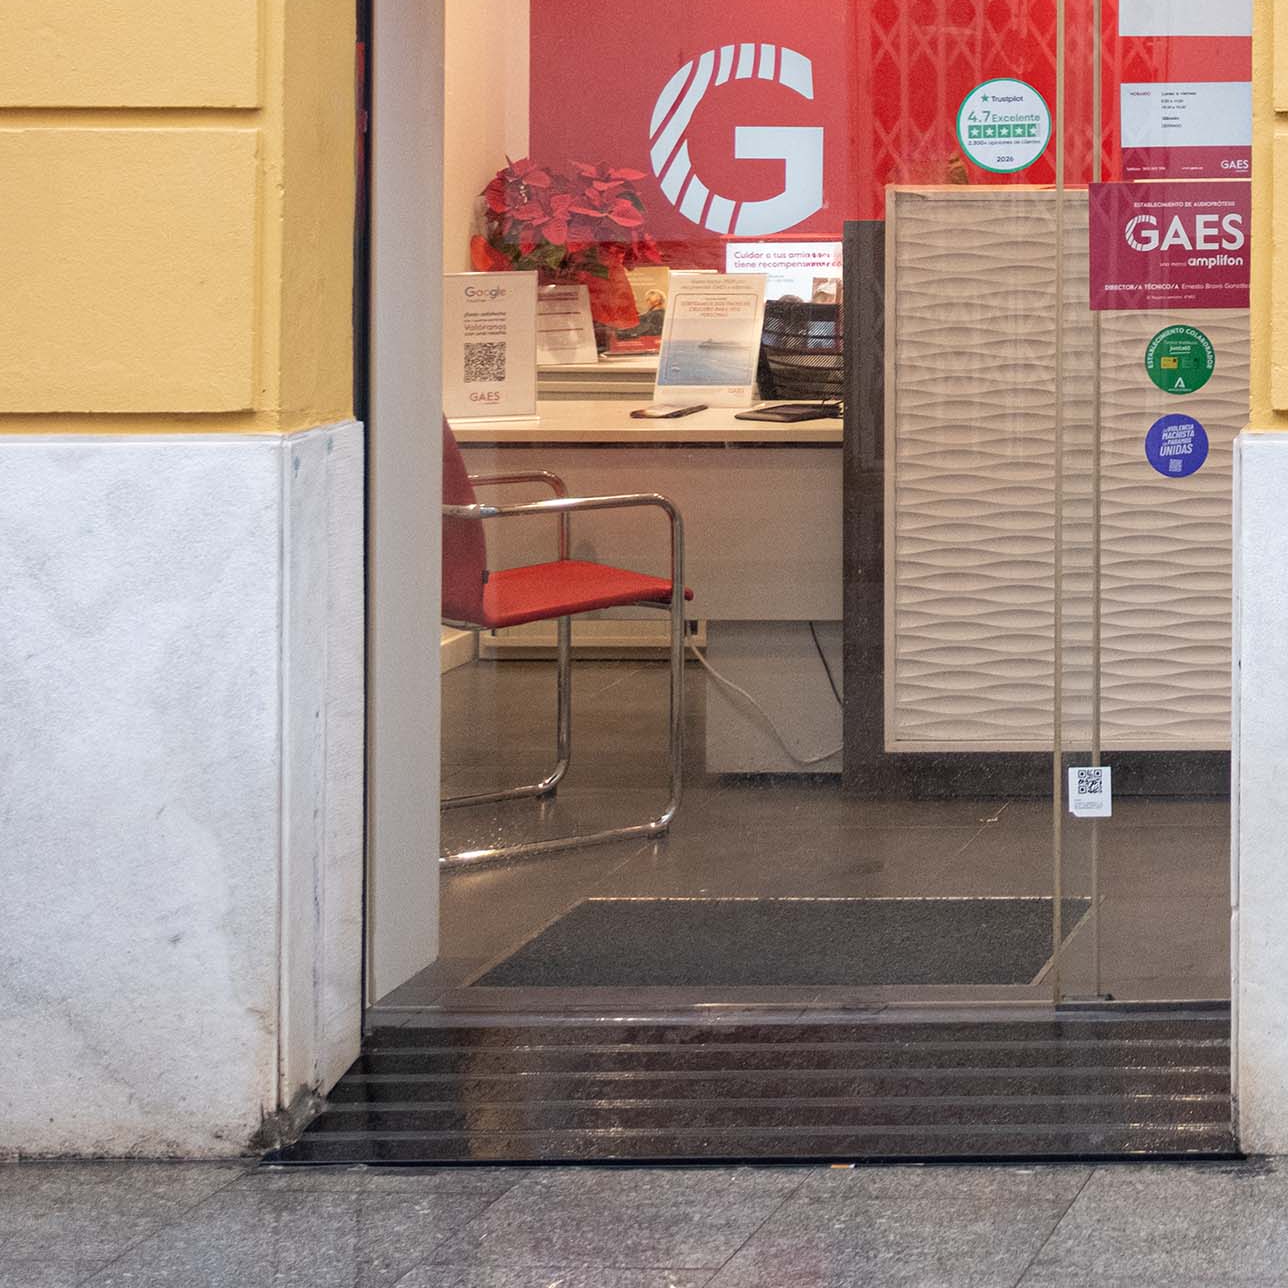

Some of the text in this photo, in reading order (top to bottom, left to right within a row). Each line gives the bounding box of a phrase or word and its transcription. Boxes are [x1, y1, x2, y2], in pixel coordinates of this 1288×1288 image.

[968, 111, 1040, 123] 4.7 Excelente
[650, 43, 824, 236] G
[1221, 160, 1249, 169] GAES
[1125, 214, 1244, 251] GAES
[1188, 255, 1243, 268] amplifon
[470, 392, 500, 402] GAES
[1160, 444, 1193, 456] UNIDAS
